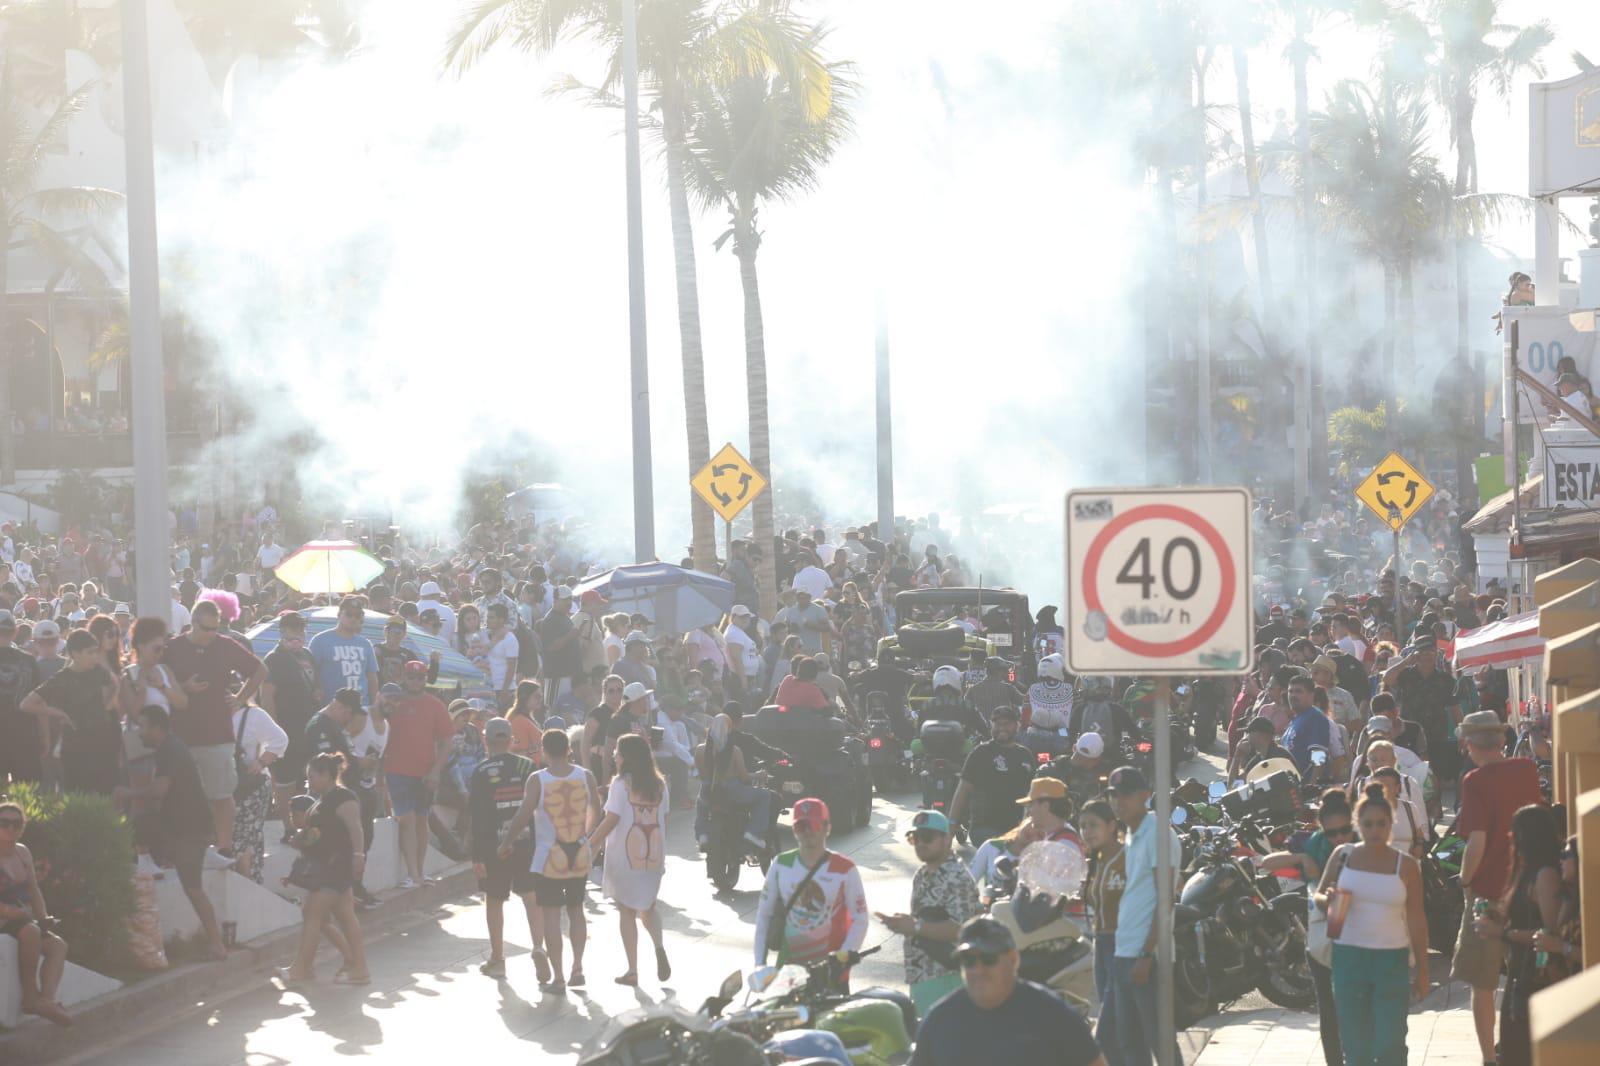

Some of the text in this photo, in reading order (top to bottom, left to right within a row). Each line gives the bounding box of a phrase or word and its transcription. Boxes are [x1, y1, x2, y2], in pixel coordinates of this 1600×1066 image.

[1115, 536, 1202, 601] 40
[333, 646, 364, 661] JUST
[341, 661, 361, 676] DO
[347, 676, 359, 689] IT
